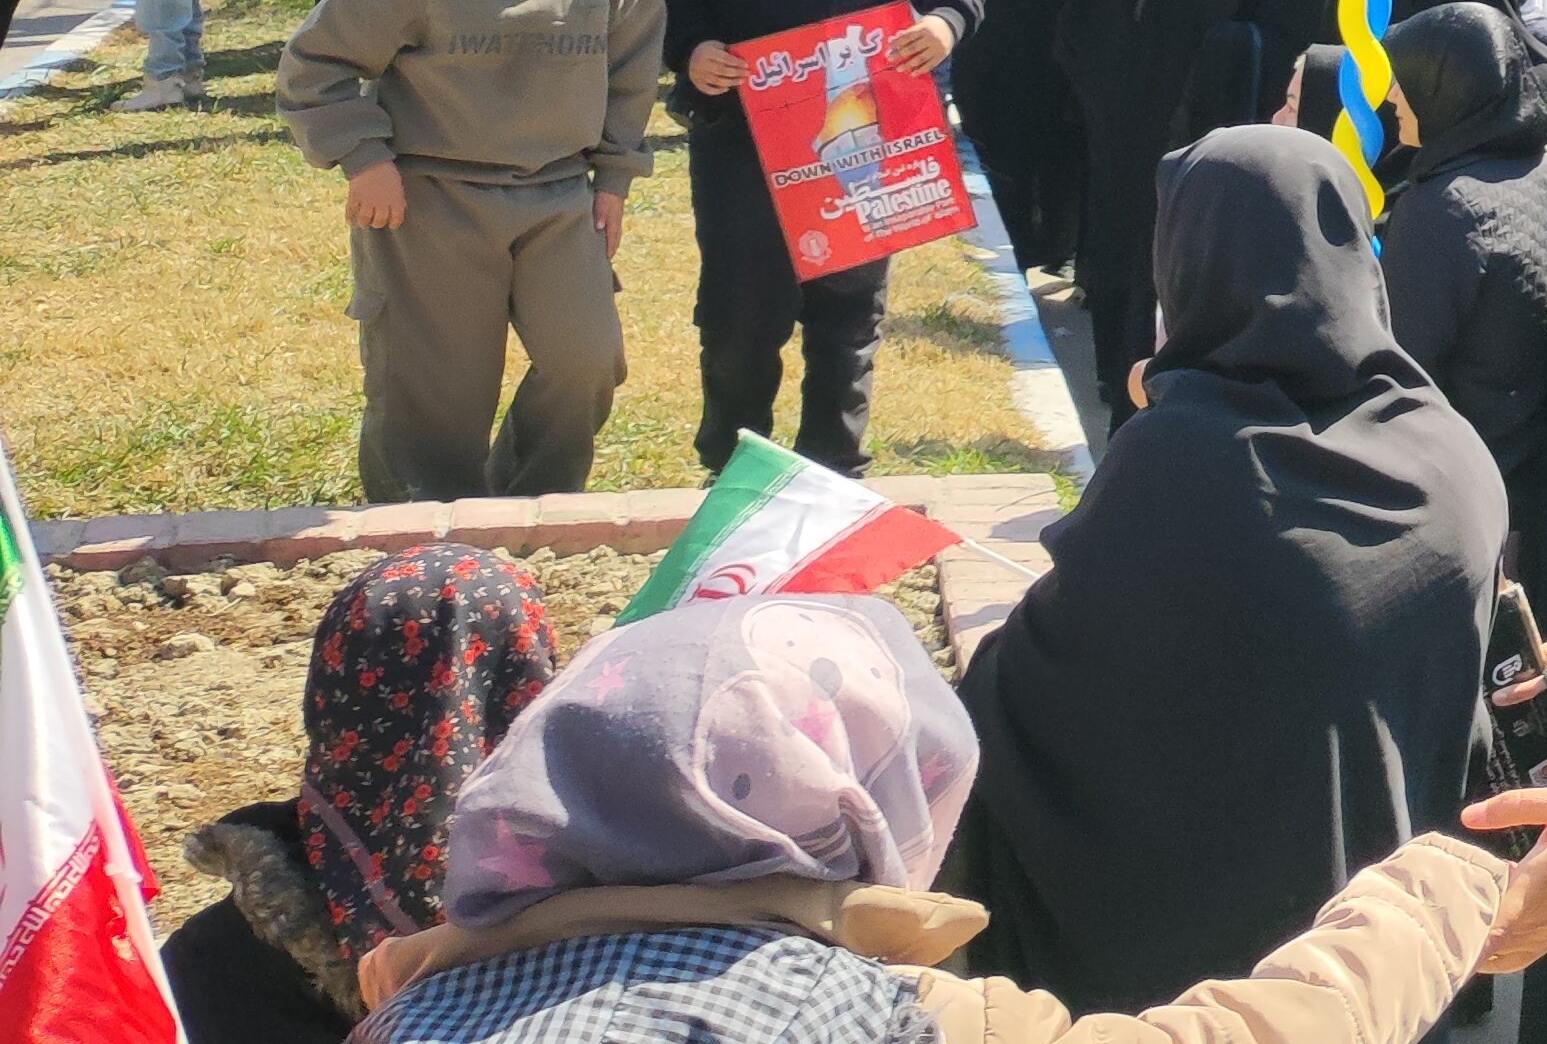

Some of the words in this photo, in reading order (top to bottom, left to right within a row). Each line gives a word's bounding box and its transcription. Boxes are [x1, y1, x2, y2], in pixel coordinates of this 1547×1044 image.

[752, 42, 829, 89] اسرائیل
[774, 160, 834, 188] DOWN
[836, 145, 884, 170] WITH
[884, 129, 945, 157] ISRAEL
[821, 156, 941, 220] فلسطین
[855, 176, 953, 225] Palestine
